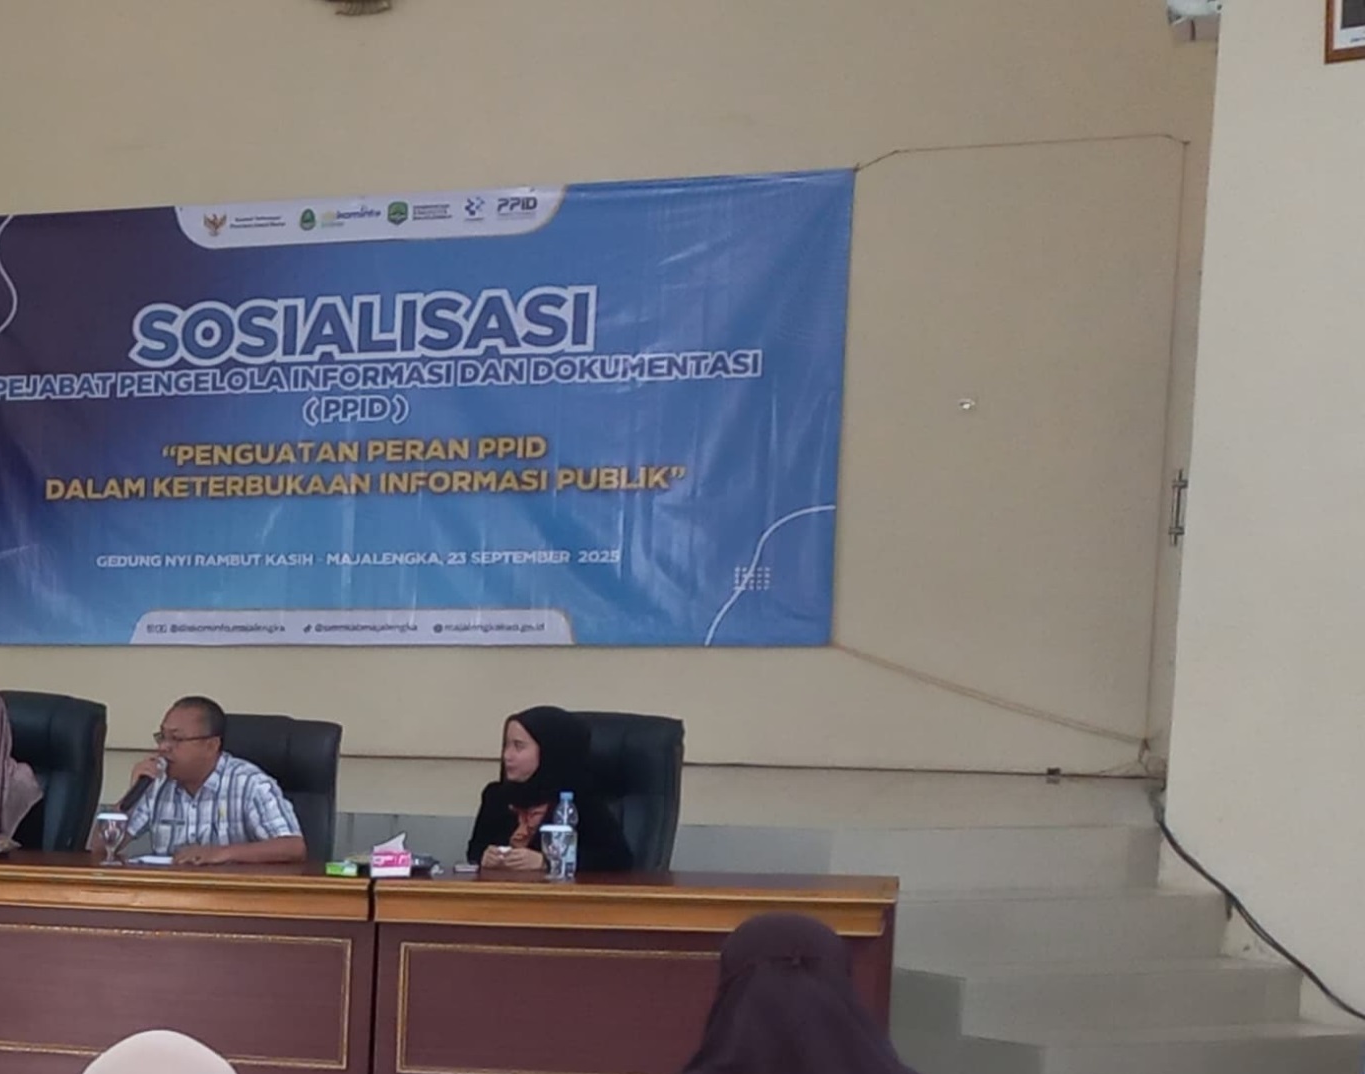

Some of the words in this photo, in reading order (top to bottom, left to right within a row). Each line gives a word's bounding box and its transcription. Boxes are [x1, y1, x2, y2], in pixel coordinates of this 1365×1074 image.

[128, 285, 597, 367] SOSIALISASI
[117, 367, 286, 397] PENGELOLA
[291, 360, 454, 392] INFORMASI
[456, 358, 527, 387] DAN
[532, 349, 762, 384] DOKUMENTASI
[366, 437, 469, 463] PERAN
[477, 435, 548, 460] PPID
[44, 475, 145, 501] DALAM
[152, 473, 371, 499] KETERBUKAAN
[379, 469, 548, 494] INFORMASI
[96, 553, 162, 568] GEDUNG
[164, 554, 192, 567] NYI
[194, 553, 261, 567] RAMBUT
[264, 552, 314, 567] KASIH
[446, 551, 467, 565] 23
[470, 550, 571, 565] SEPTEMBER
